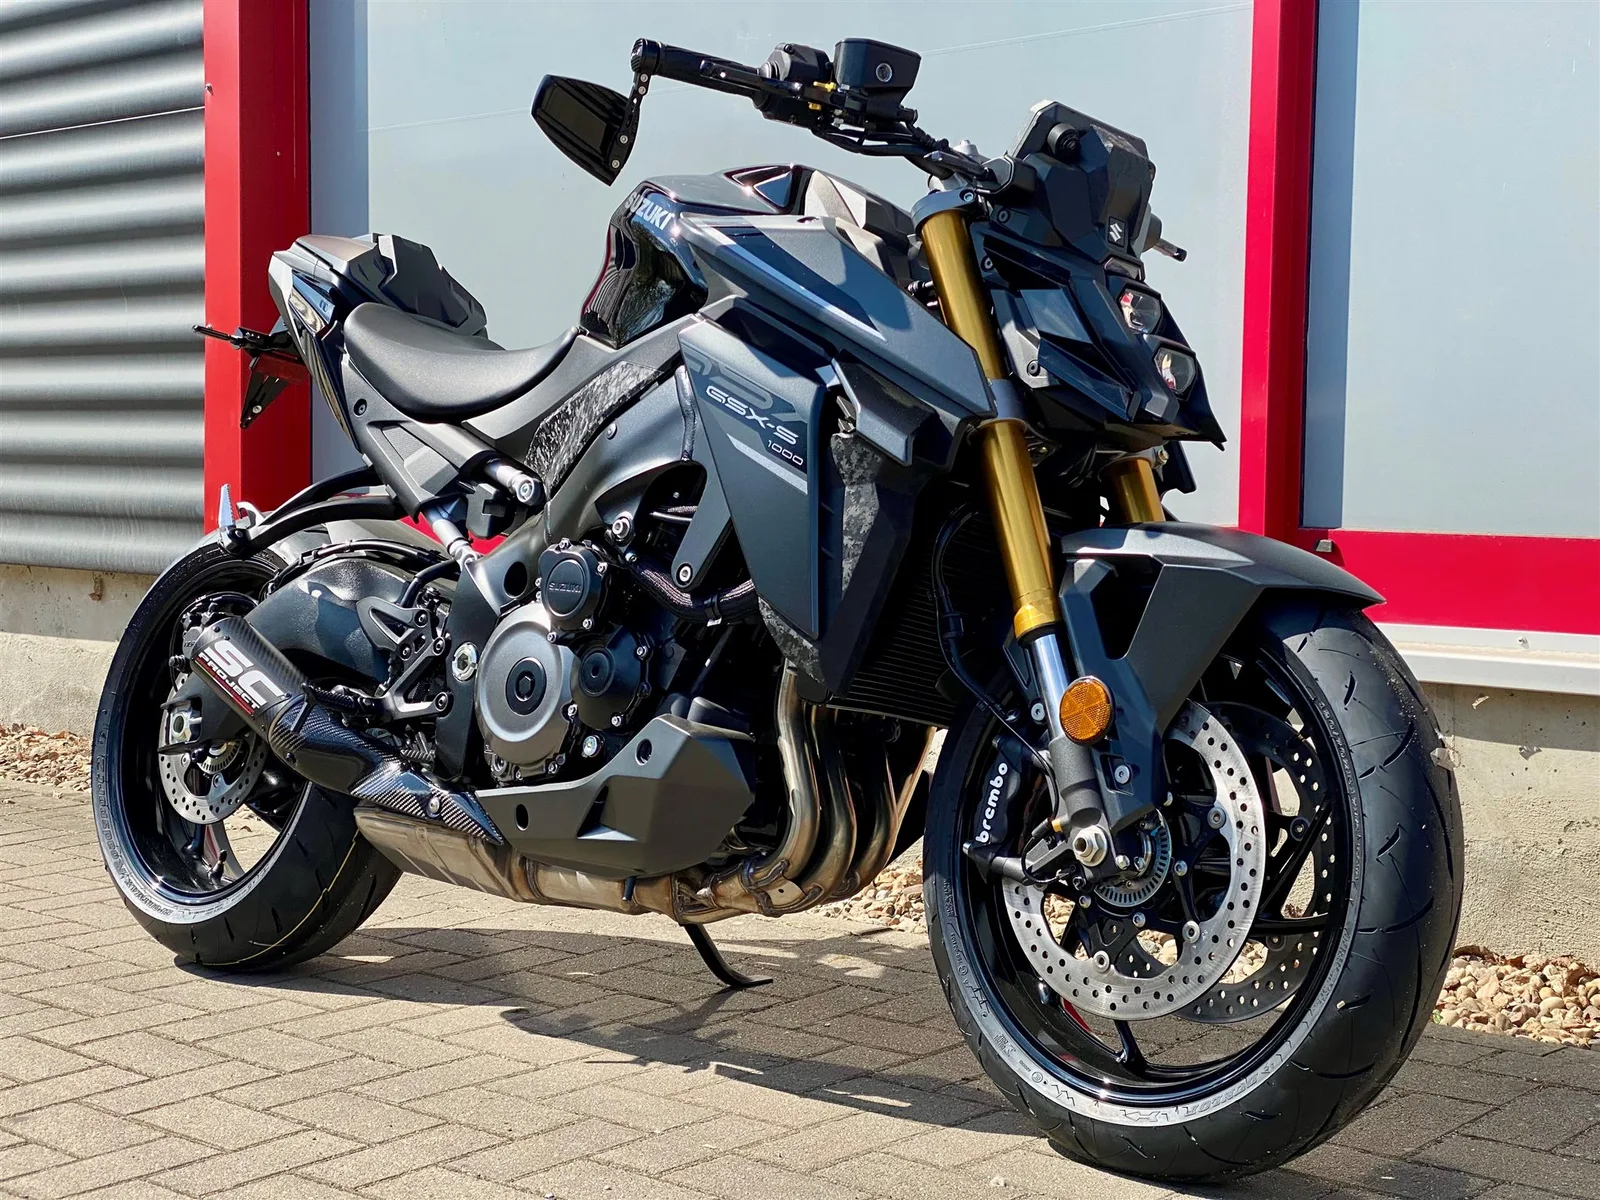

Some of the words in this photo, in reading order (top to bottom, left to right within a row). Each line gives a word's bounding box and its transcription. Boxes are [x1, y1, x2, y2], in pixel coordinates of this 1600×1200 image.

[625, 192, 675, 231] SUZUKI
[706, 385, 799, 445] GSX-S
[768, 440, 804, 466] 1000
[549, 582, 581, 594] SUZUKI
[198, 652, 260, 710] PROJECT
[203, 639, 285, 707] SC
[975, 762, 1008, 843] brembo
